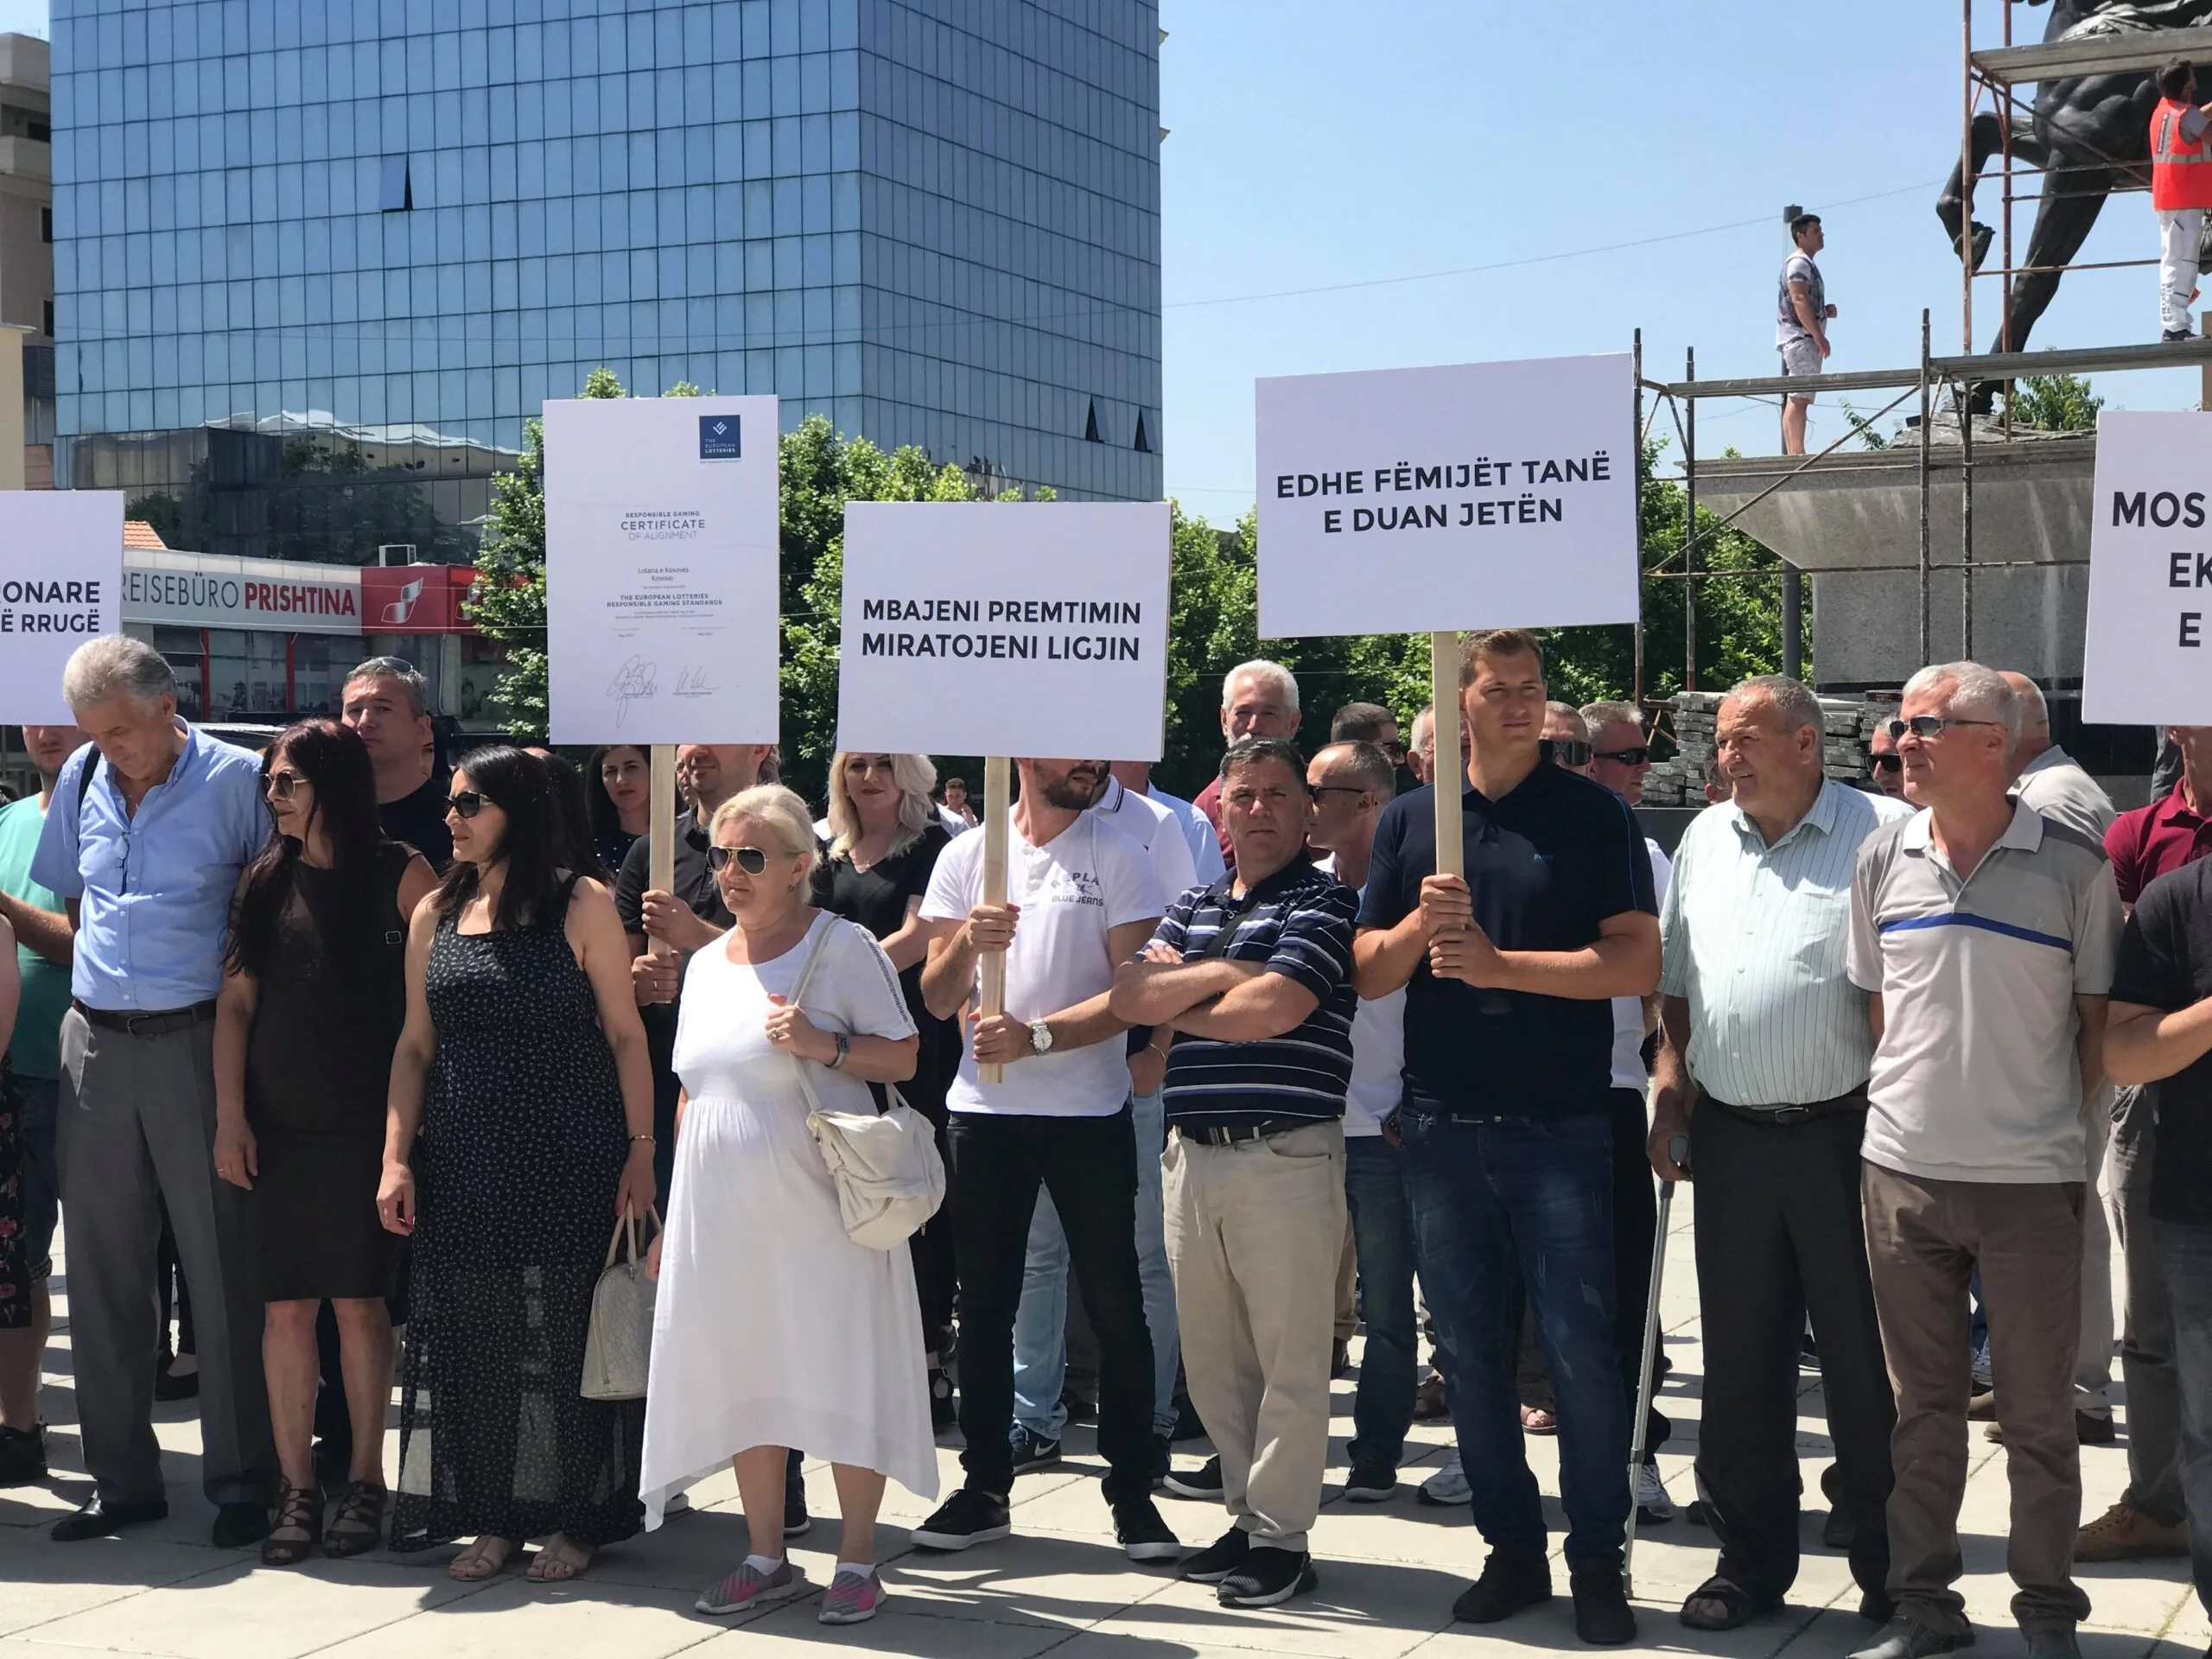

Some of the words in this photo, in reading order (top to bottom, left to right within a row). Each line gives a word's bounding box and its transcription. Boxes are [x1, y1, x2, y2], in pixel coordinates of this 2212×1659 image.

[1277, 470, 1364, 499] EDHE
[1374, 456, 1513, 493] FËMIJËT
[1521, 449, 1611, 485] TANË
[1324, 509, 1343, 534] E
[1352, 504, 1448, 532] DUAN
[1458, 493, 1563, 526] JETËN
[2112, 491, 2206, 529] MOS
[620, 519, 706, 531] CERTIFICATE
[628, 532, 641, 541] OF
[644, 531, 699, 540] ALIGNMENT
[0, 581, 100, 603] ONARE
[244, 582, 356, 616] PRISHTINA
[21, 608, 100, 632] RRUGË
[863, 599, 980, 622] MBAJENI
[988, 601, 1141, 624] PREMTIMIN
[2178, 612, 2202, 647] E
[862, 632, 1038, 659] MIRATOJENI
[1046, 636, 1141, 661] LIGJIN
[1052, 894, 1075, 903] BLUE
[1075, 895, 1104, 906] JEANS
